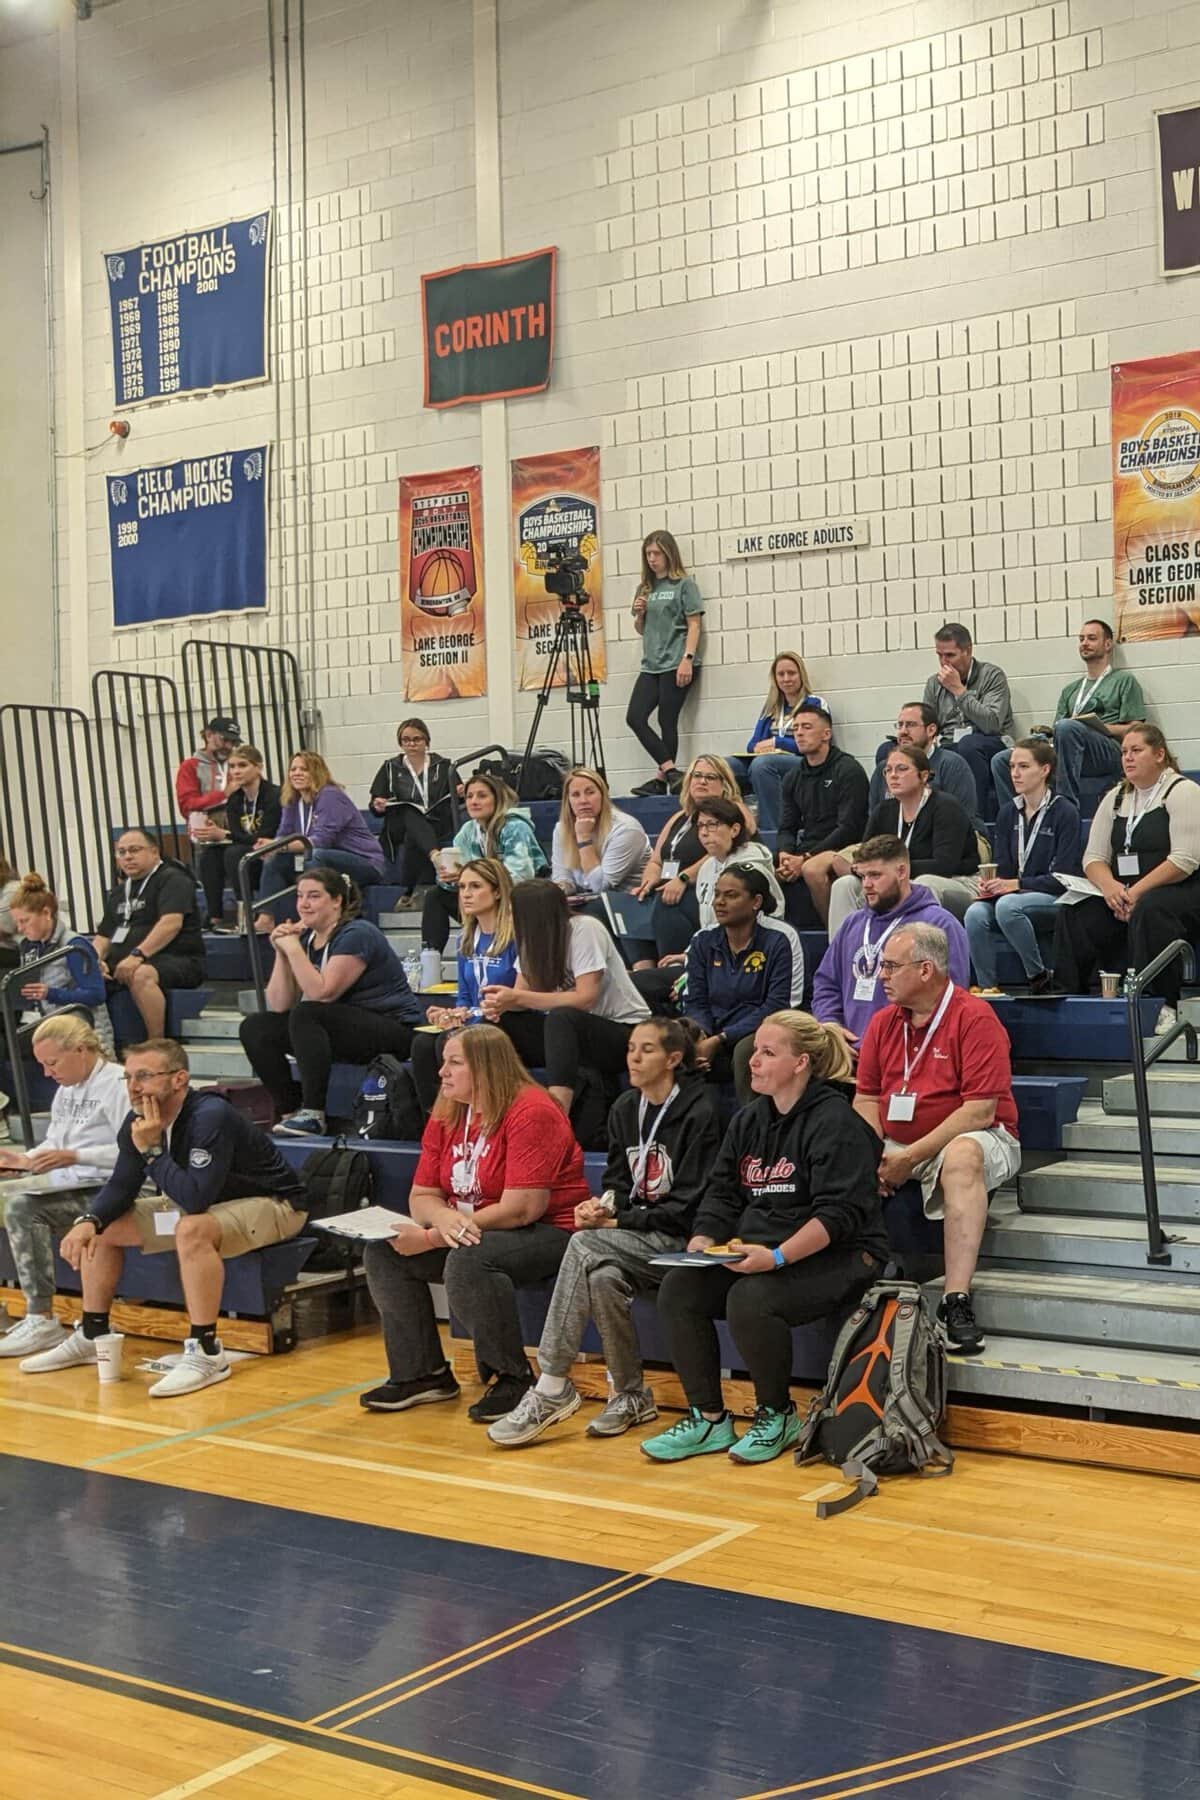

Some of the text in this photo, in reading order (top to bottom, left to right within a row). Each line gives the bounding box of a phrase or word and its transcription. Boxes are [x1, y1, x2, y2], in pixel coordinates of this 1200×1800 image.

[141, 228, 233, 271] FOOTBALL
[138, 250, 236, 294] CHAMPIONS
[196, 279, 218, 294] 2001
[434, 303, 545, 358] CORINTH
[121, 335, 140, 350] 1971
[159, 338, 180, 353] 1990
[122, 347, 142, 363] 1972
[159, 351, 178, 367] 1991
[123, 360, 143, 375] 1974
[123, 373, 143, 388] 1975
[1120, 439, 1150, 454] BOYS
[137, 456, 233, 497] FIELD HOCKEY
[138, 479, 233, 519] CHAMPIONS
[523, 508, 592, 528] BOYS BASKETBALL
[117, 521, 138, 535] 1998
[522, 519, 594, 540] CHAMPIONSHIPS
[118, 533, 138, 548] 2000
[737, 526, 854, 553] LAKE GEORGE ADULTS
[1145, 542, 1189, 562] CLASS
[1129, 566, 1162, 585] LAKE
[1139, 584, 1195, 605] SECTION
[529, 623, 552, 639] LAKE
[414, 633, 475, 651] LAKE GEORGE
[420, 650, 468, 667] SECTION II
